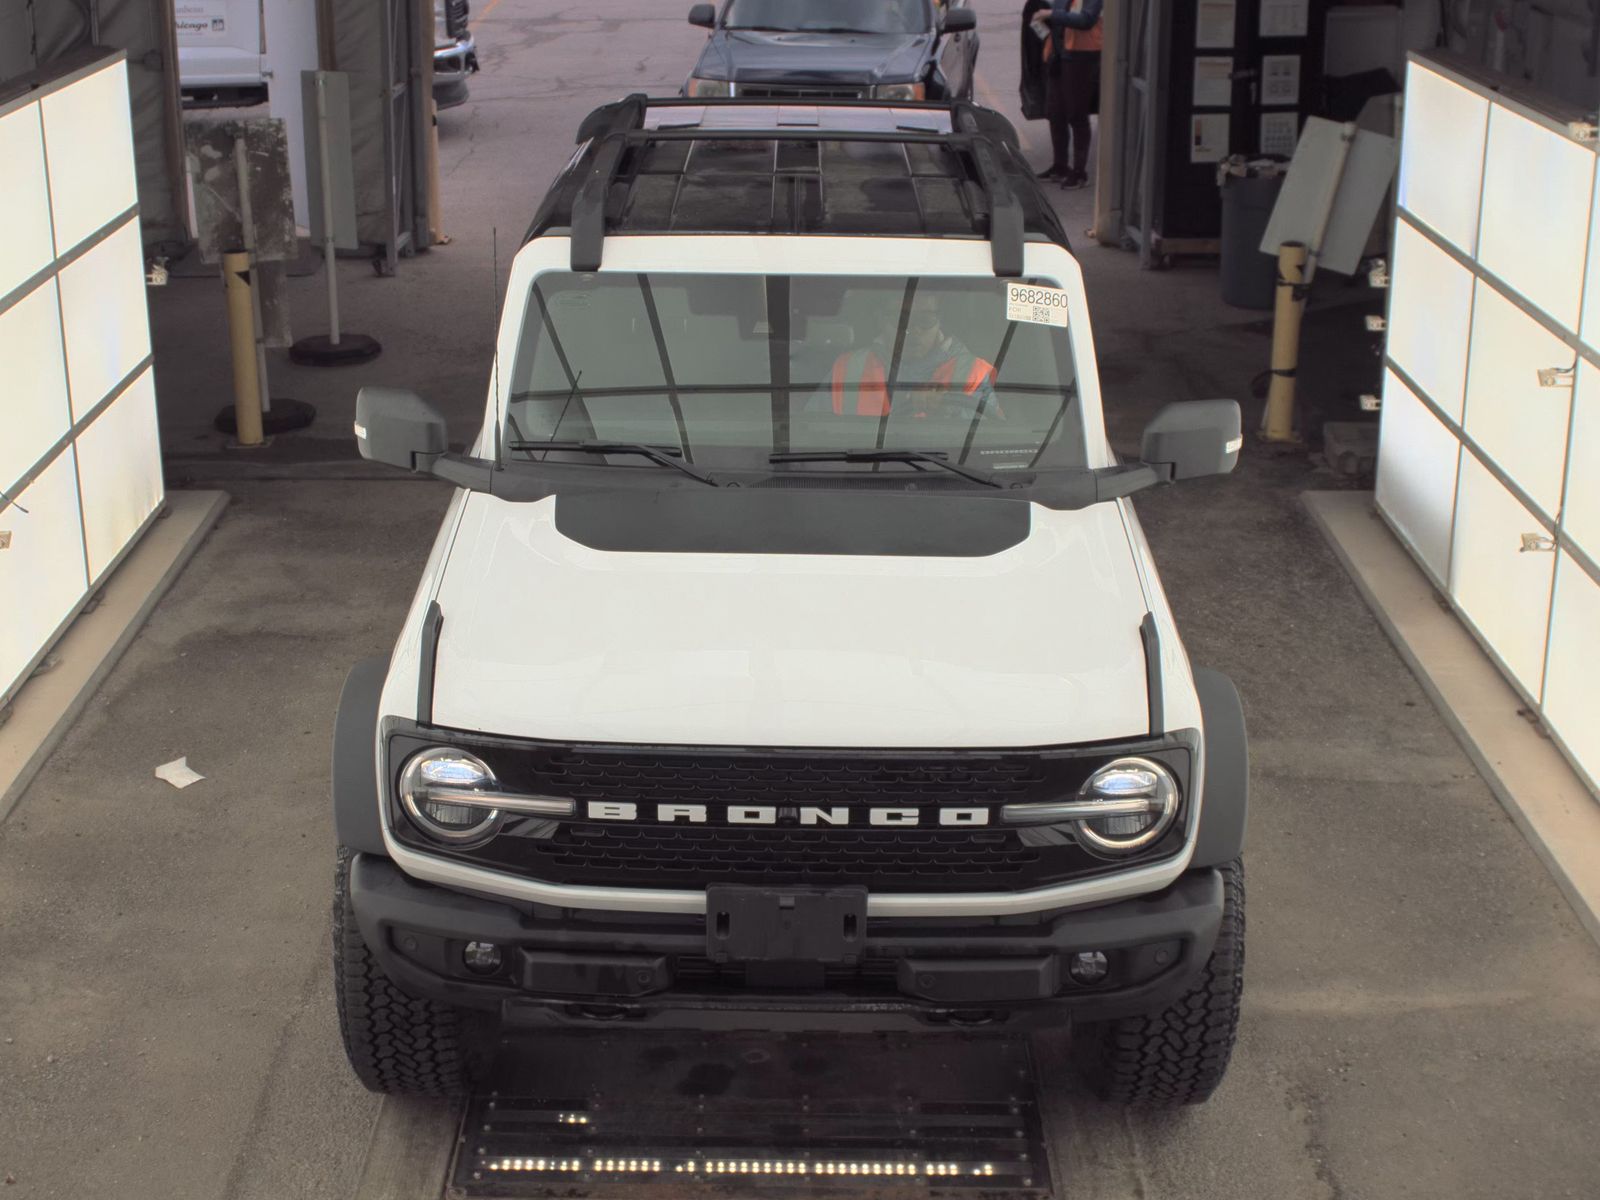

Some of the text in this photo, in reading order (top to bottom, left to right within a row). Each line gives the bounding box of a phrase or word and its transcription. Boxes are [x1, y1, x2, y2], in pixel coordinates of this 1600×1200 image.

[176, 20, 208, 31] hicago
[1010, 287, 1068, 308] 9682860
[588, 801, 989, 825] BRONCO
